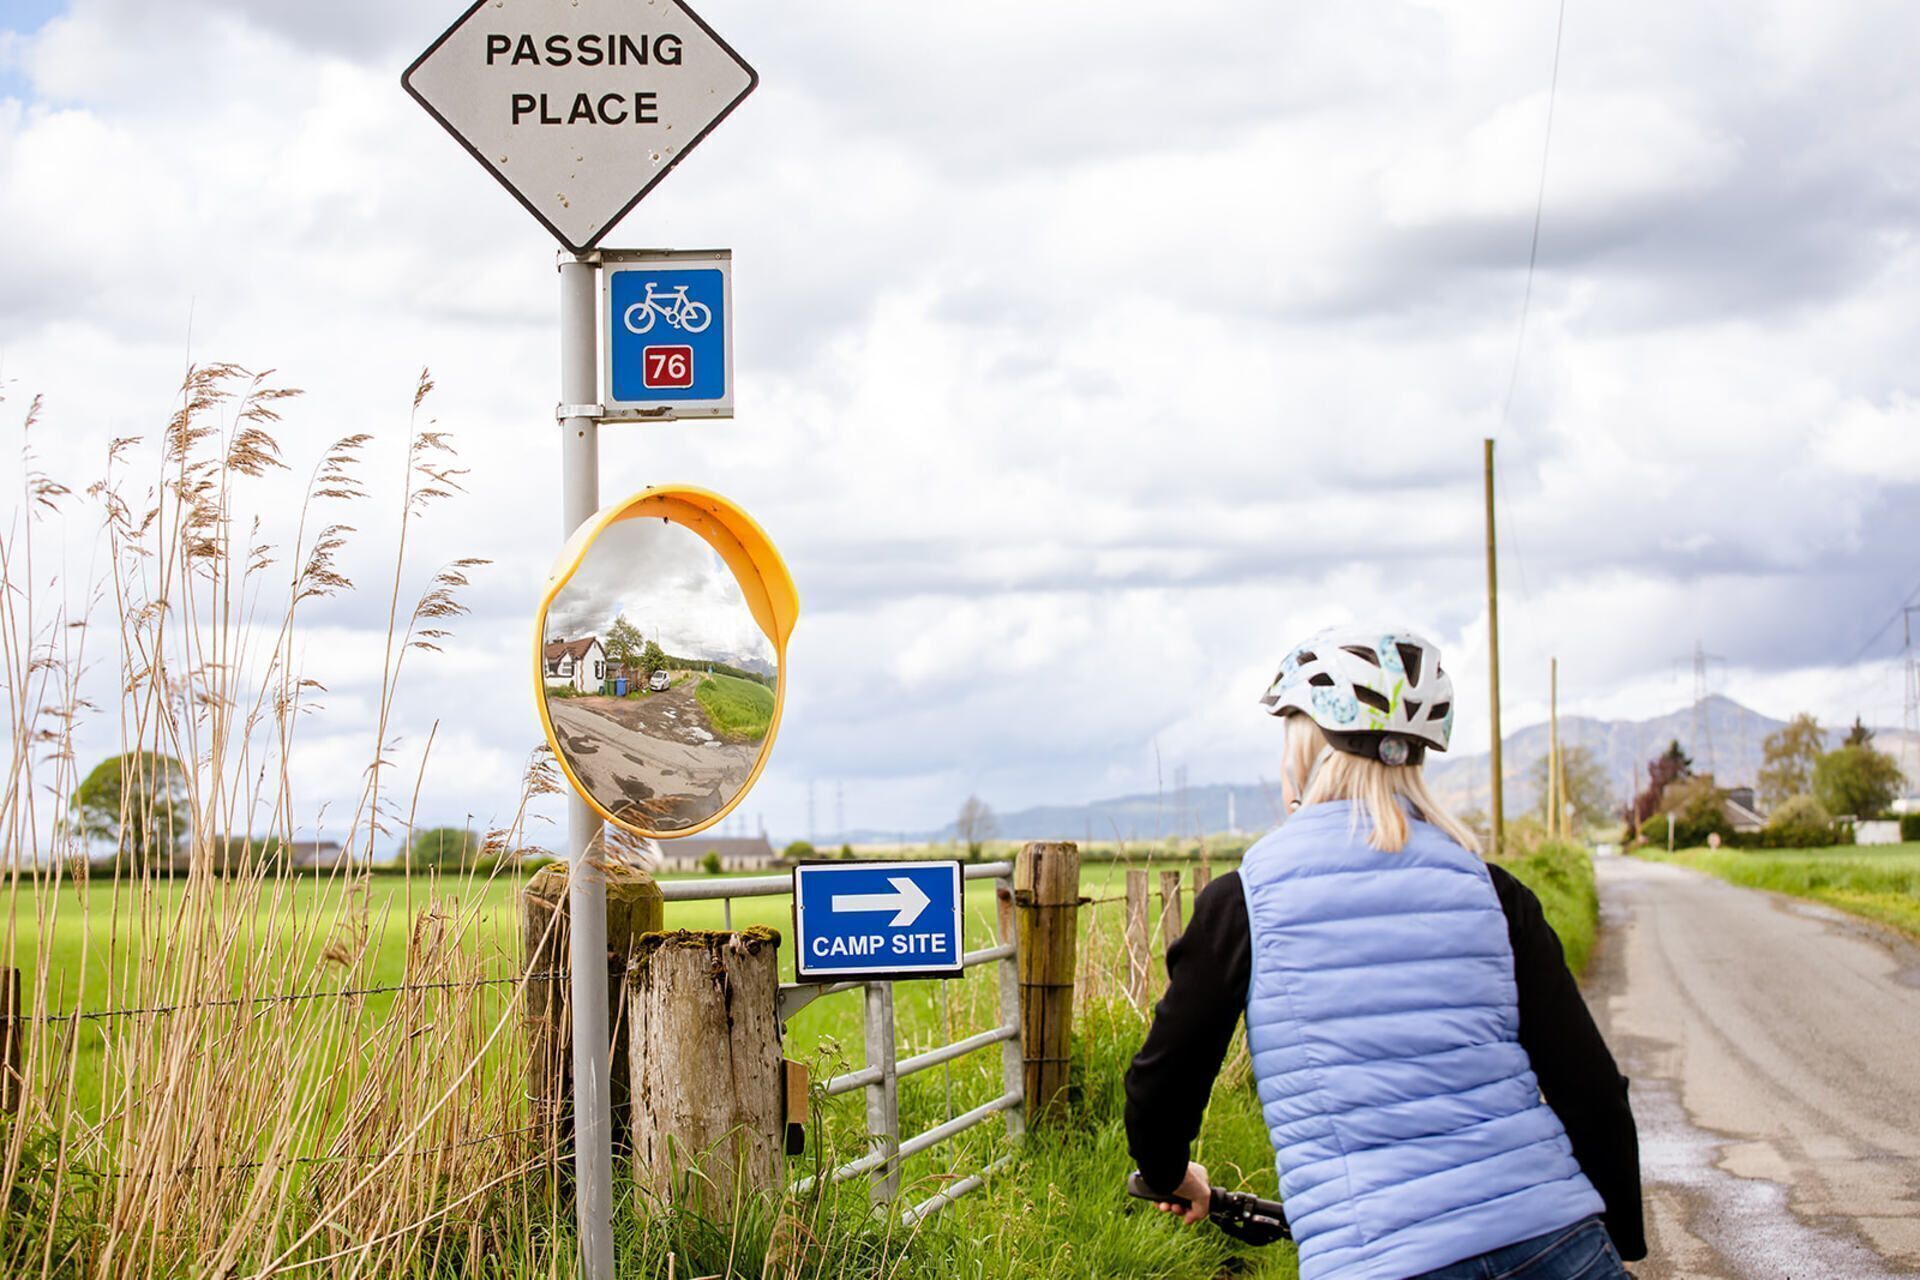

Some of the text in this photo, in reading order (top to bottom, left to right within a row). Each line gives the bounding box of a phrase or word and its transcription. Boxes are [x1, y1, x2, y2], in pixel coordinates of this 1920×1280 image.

[486, 34, 683, 66] PASSING
[512, 92, 659, 125] PLACE
[649, 354, 686, 379] 76
[812, 933, 946, 957] CAMP SITE
